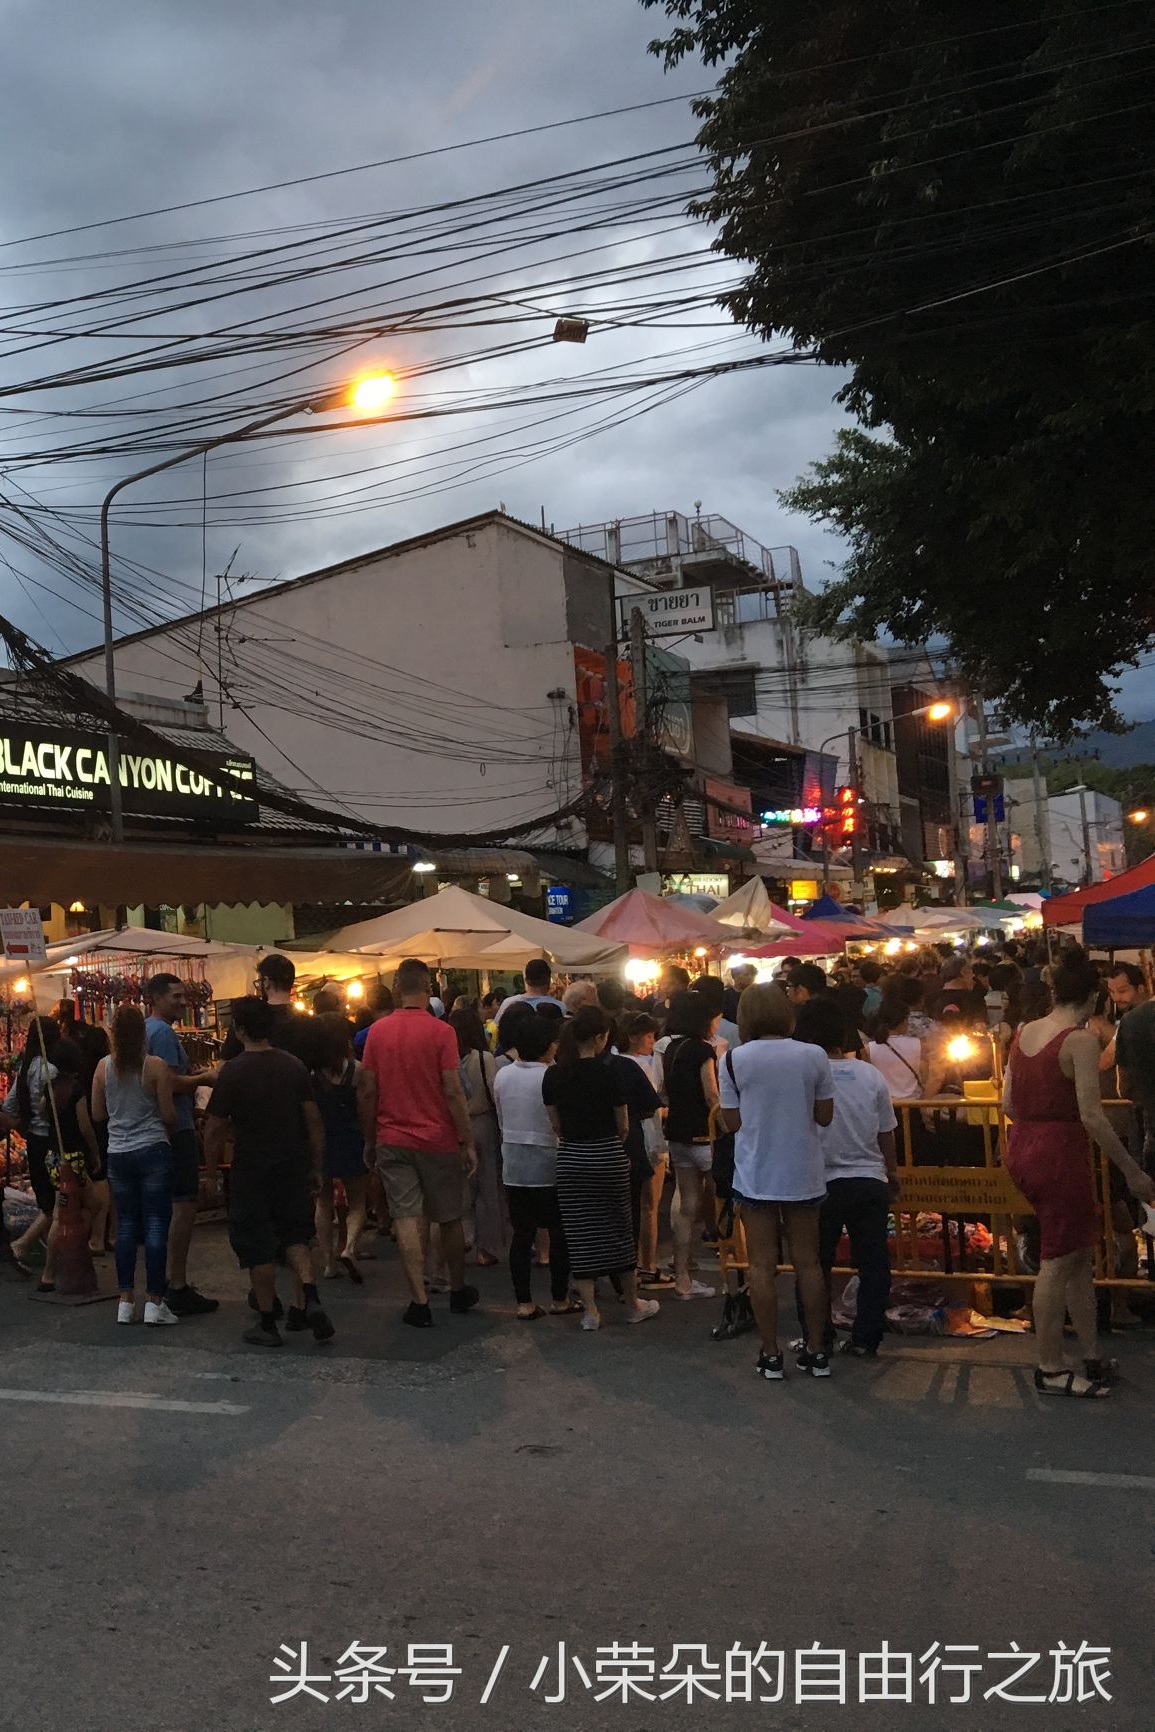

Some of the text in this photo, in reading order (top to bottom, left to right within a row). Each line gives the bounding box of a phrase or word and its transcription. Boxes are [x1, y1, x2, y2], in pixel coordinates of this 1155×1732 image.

[647, 592, 700, 612] ขายยา
[653, 615, 706, 629] TIGER BALM
[47, 784, 64, 798] Thai
[65, 785, 94, 801] Cuisine
[686, 884, 721, 896] THAI
